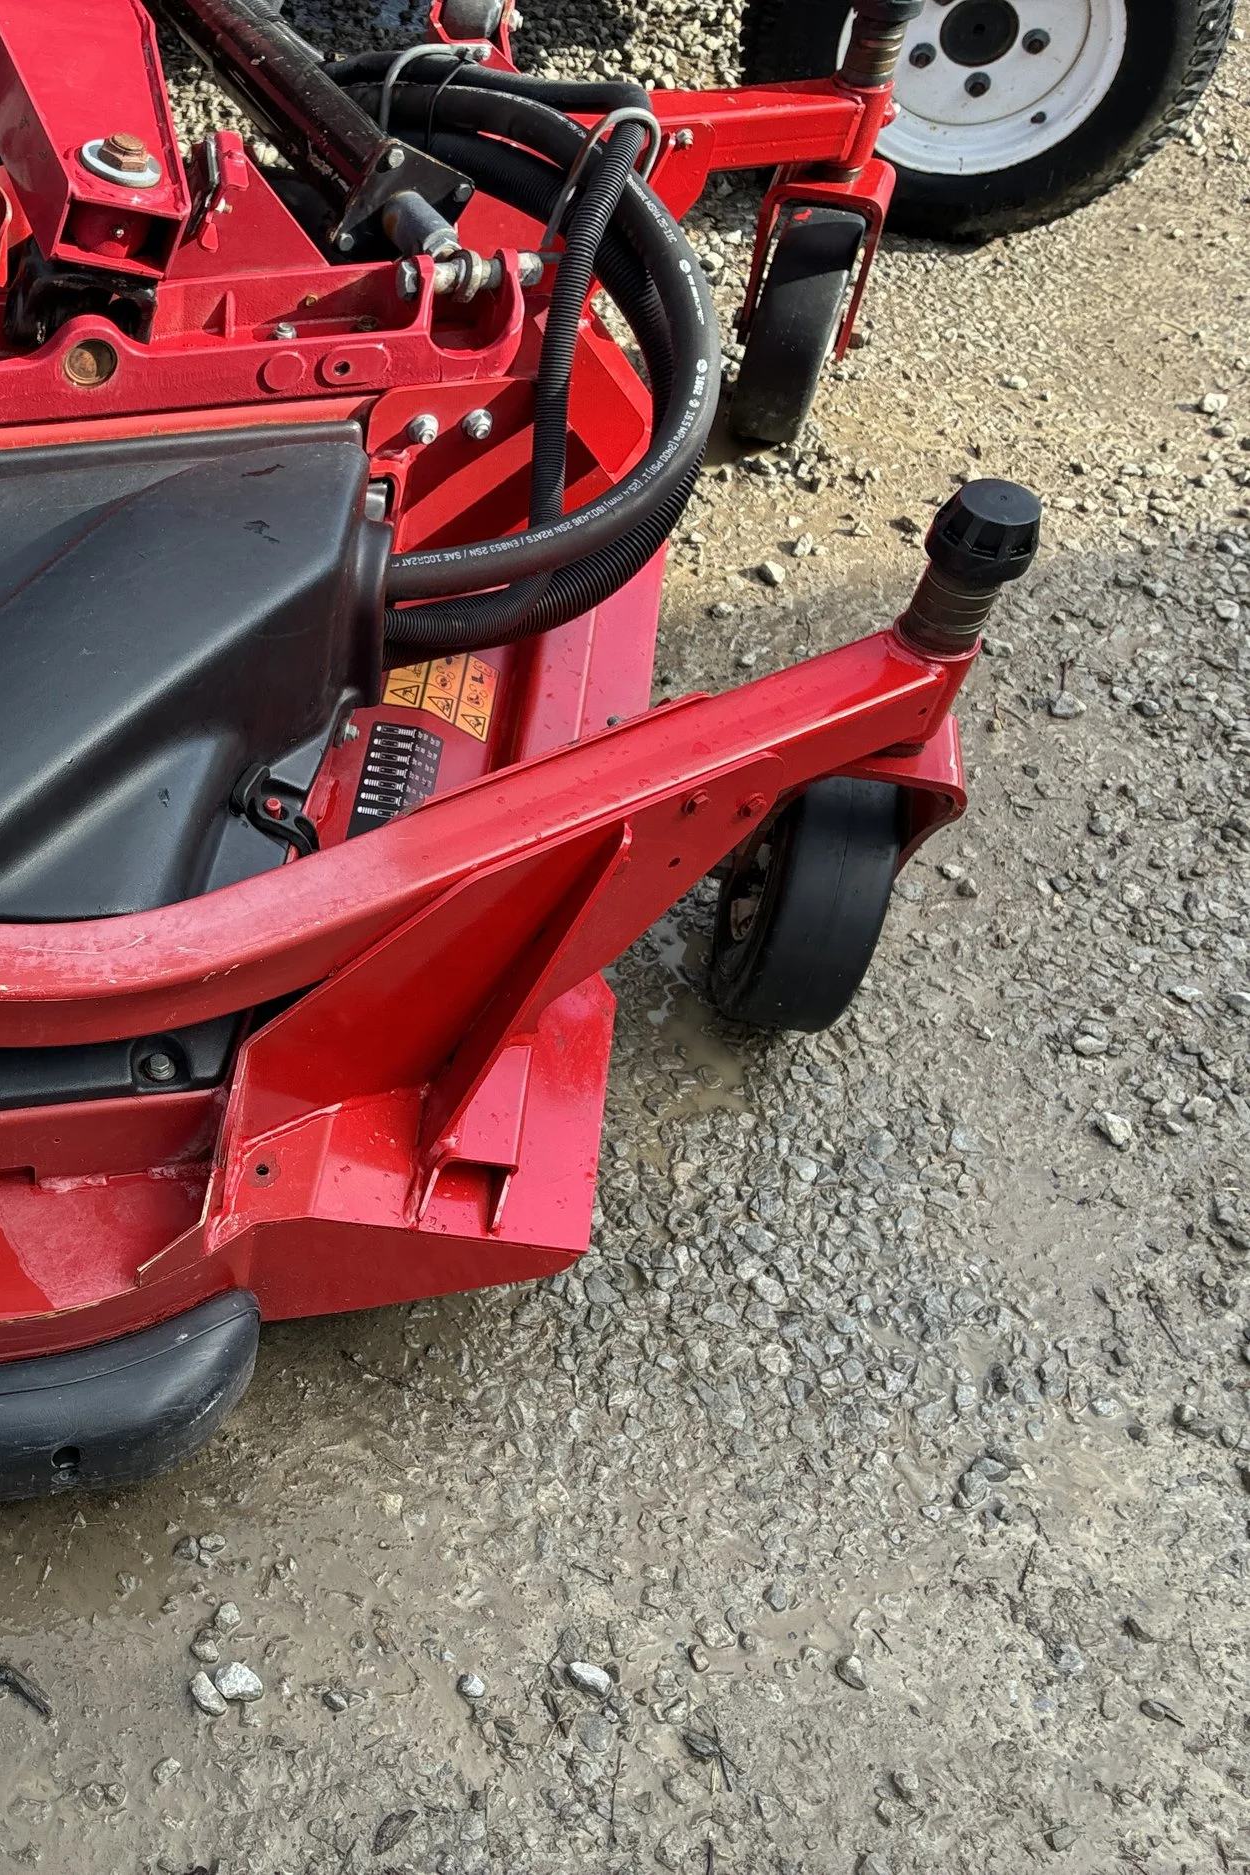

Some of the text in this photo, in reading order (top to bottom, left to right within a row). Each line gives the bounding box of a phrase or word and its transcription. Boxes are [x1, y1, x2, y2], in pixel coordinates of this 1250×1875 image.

[553, 521, 572, 534] 2SN
[525, 528, 553, 544] R2ATS
[468, 546, 487, 556] 2SN
[489, 538, 519, 553] EN853
[442, 551, 461, 561] SAE
